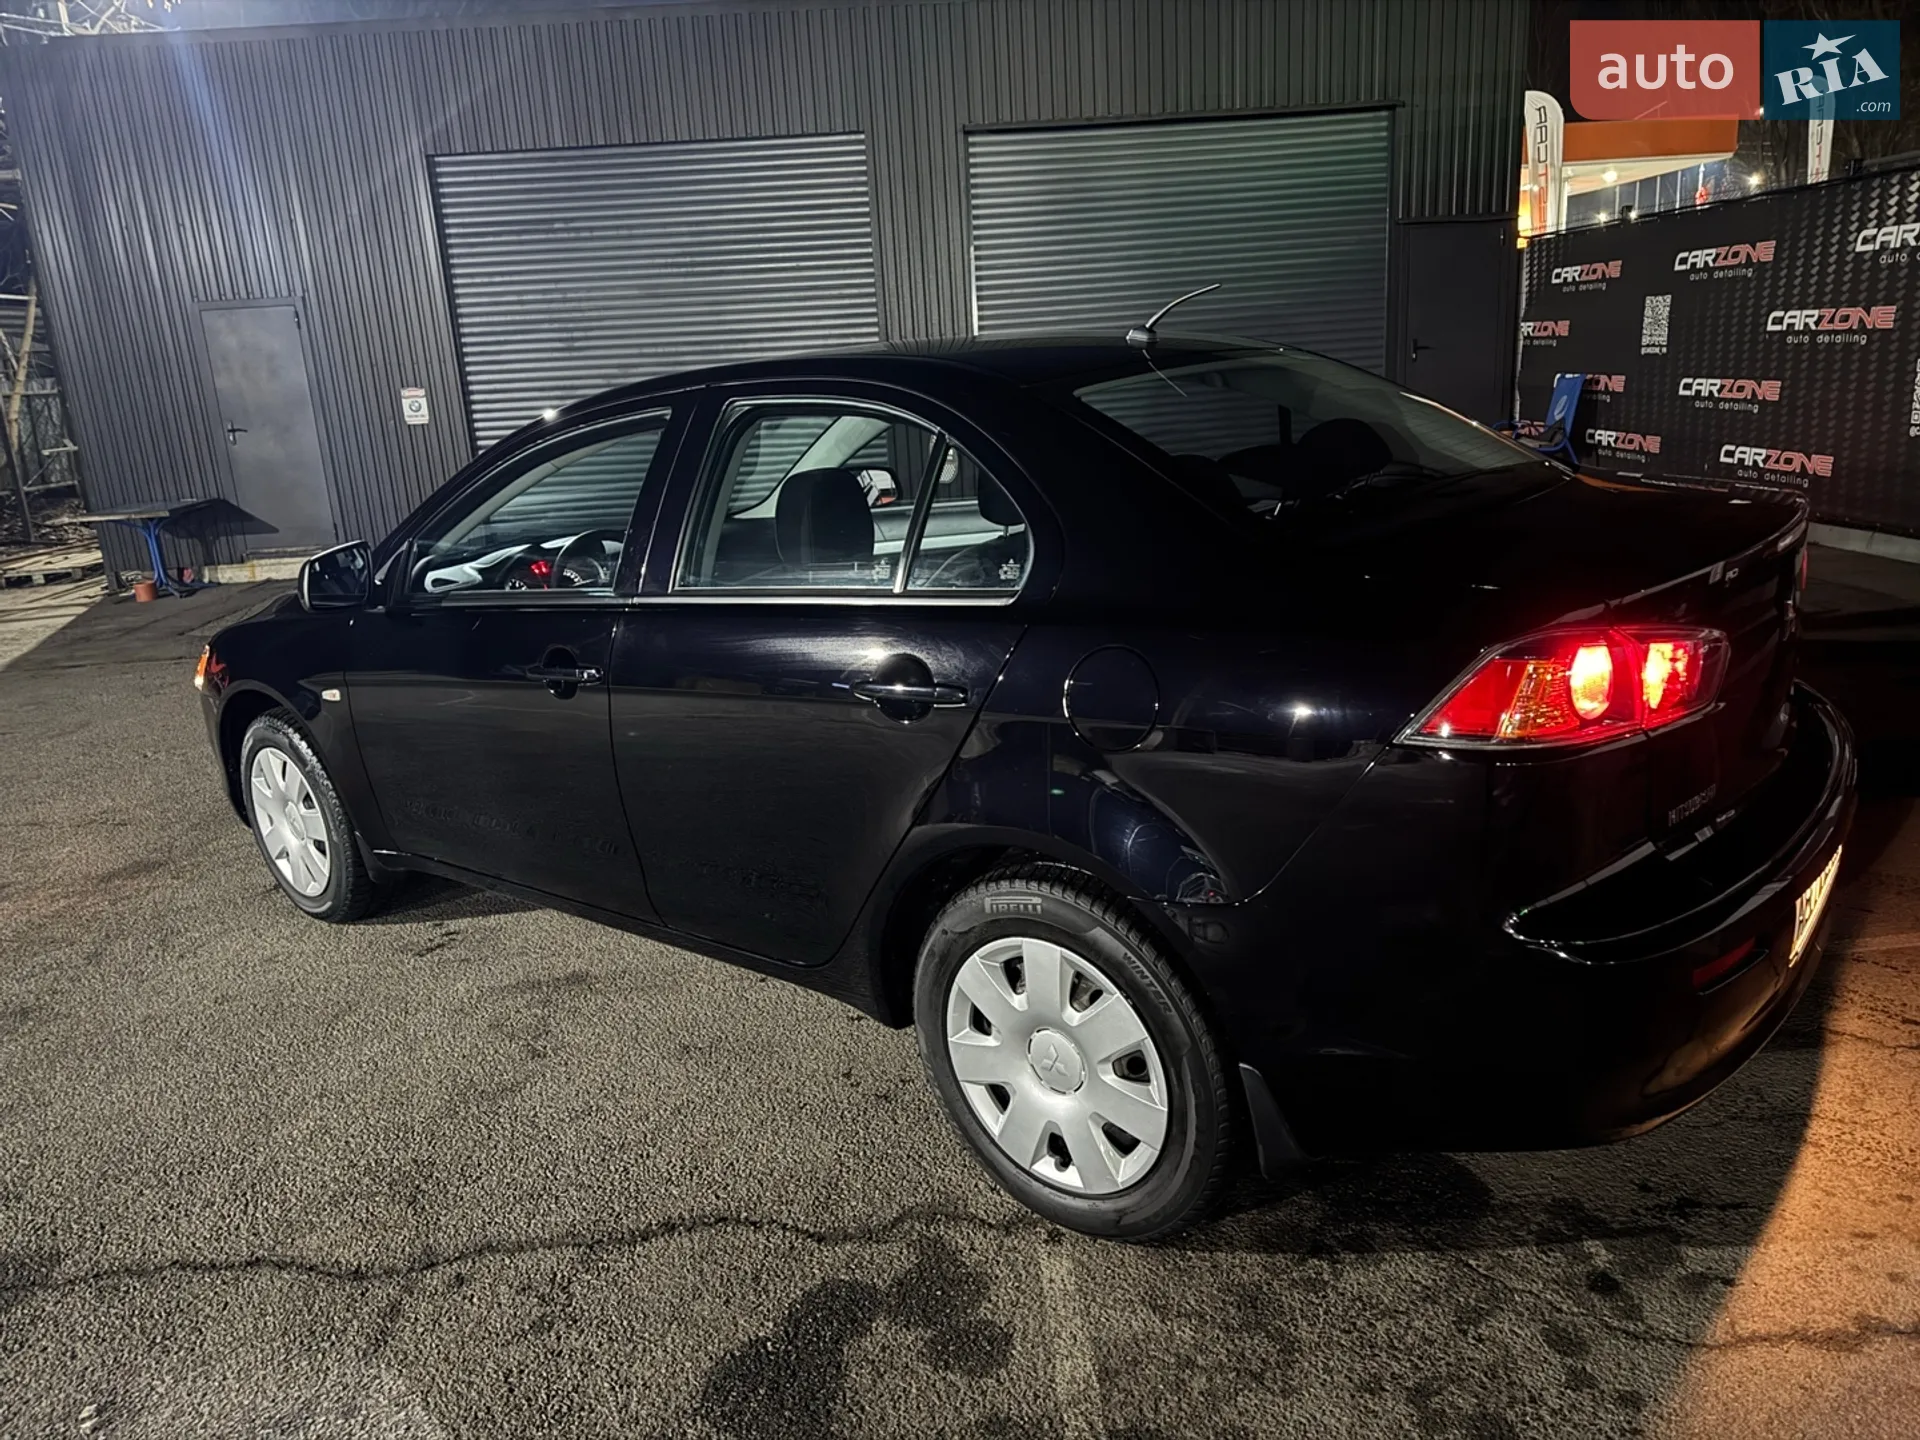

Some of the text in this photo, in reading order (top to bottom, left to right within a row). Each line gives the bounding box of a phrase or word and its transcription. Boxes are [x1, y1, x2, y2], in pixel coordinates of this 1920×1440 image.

[1855, 222, 1920, 253] CAR
[1674, 240, 1777, 271] CARZONE
[1879, 253, 1908, 264] auto
[1551, 260, 1622, 284] CARZONE
[1689, 268, 1753, 281] auto detailing
[1520, 320, 1570, 337] ARZONE
[1766, 306, 1897, 331] CARZONE
[1786, 333, 1867, 345] auto detailing
[1678, 377, 1782, 401] CARZONE
[1694, 400, 1759, 414] auto detailing
[1585, 428, 1661, 454] CARZONE
[1719, 444, 1834, 477] CARZONE
[1737, 469, 1809, 488] auto detailing
[984, 896, 1042, 915] PIRELLI
